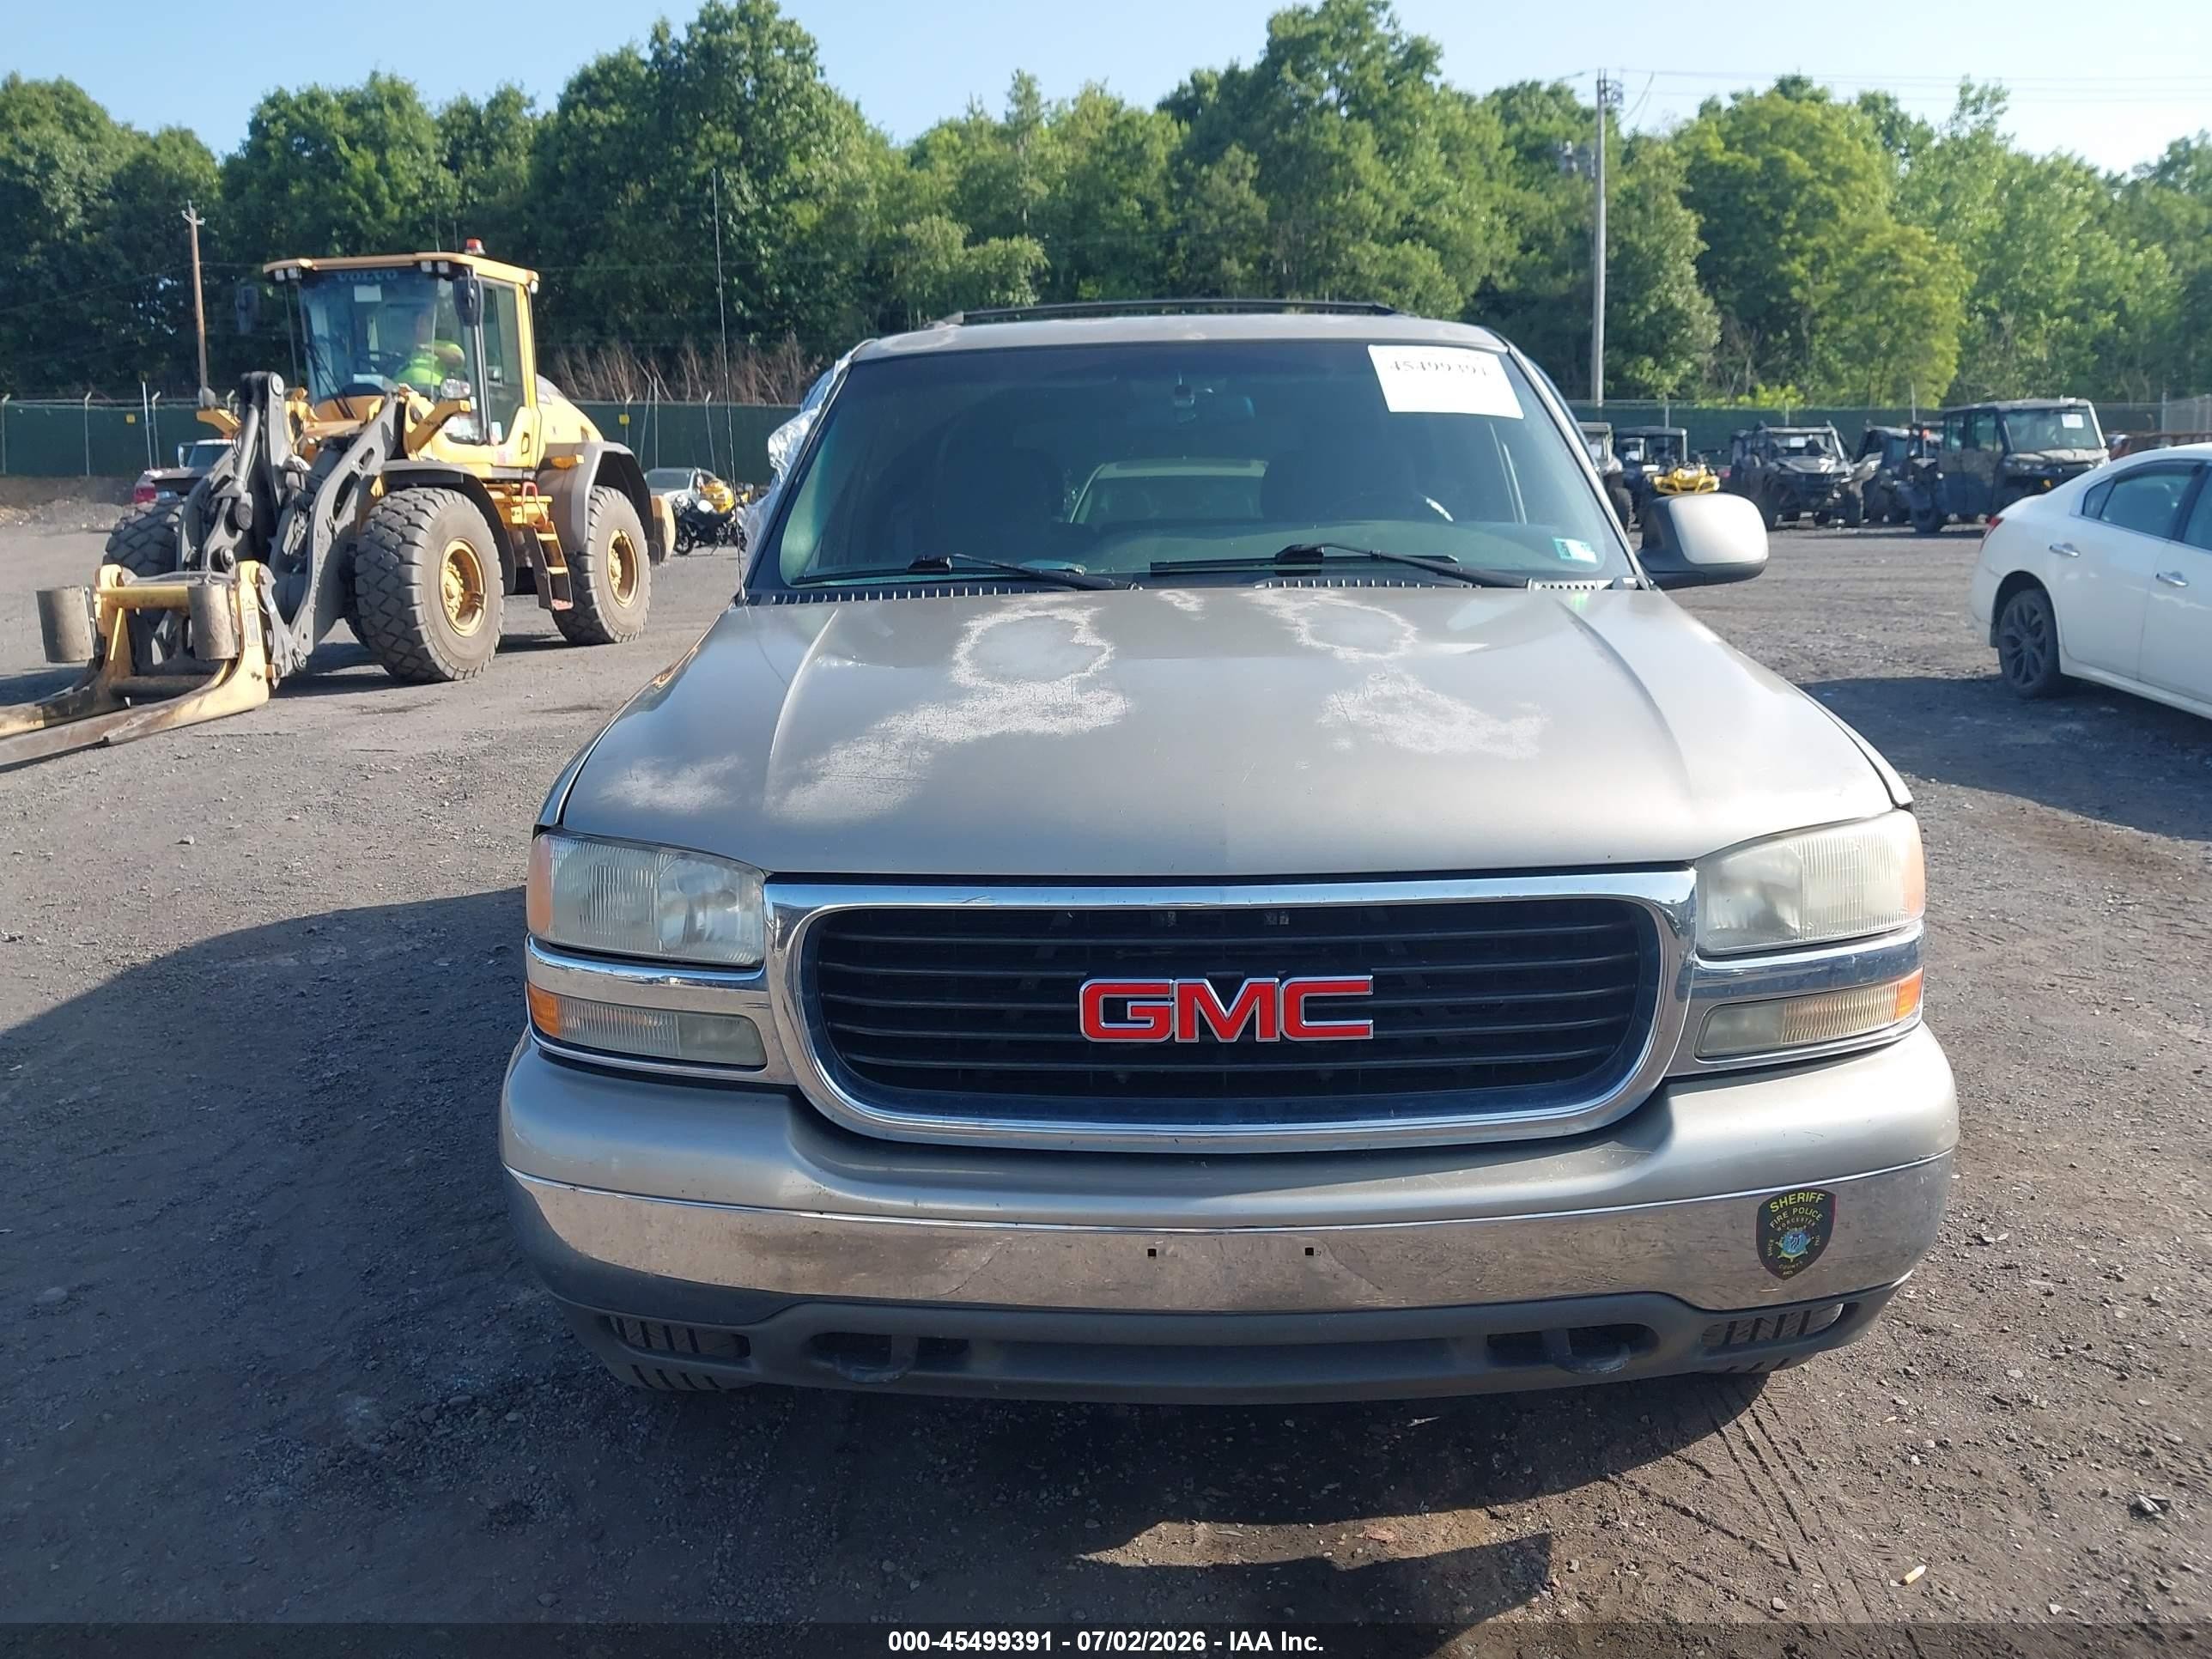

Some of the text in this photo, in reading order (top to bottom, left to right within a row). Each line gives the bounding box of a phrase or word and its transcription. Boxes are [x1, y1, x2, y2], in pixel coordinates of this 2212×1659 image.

[1079, 975, 1373, 1042] GMC
[1770, 1192, 1825, 1212] SHERIFF
[1769, 1207, 1822, 1228] FIRE POLICE
